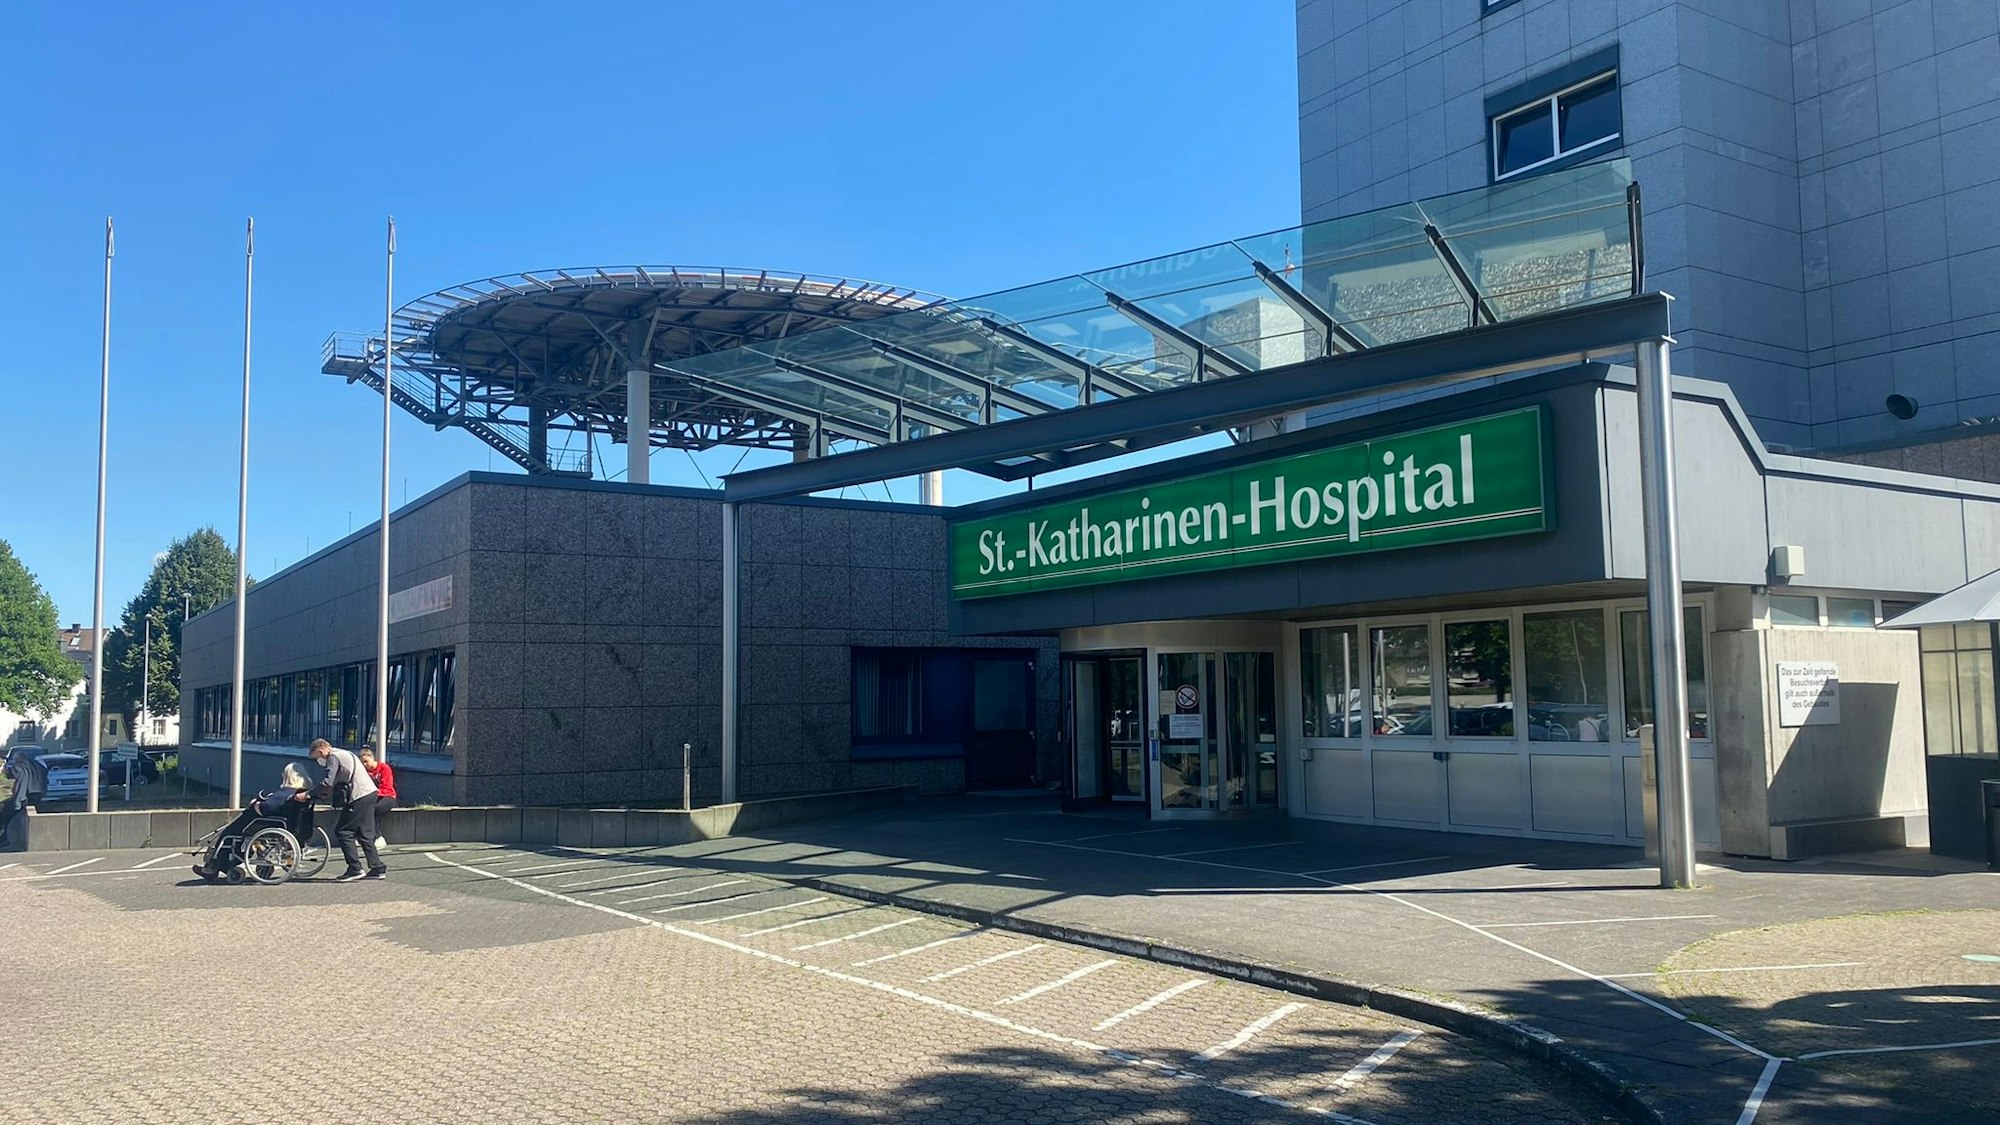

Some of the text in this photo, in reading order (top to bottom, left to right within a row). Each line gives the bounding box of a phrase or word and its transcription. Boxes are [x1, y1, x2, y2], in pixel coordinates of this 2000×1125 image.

[977, 433, 1476, 575] St.-Katharinen-Hospital
[1781, 667, 1792, 676] Das
[1803, 667, 1813, 676] Zeit
[1795, 688, 1809, 697] auch
[1792, 700, 1803, 709] des
